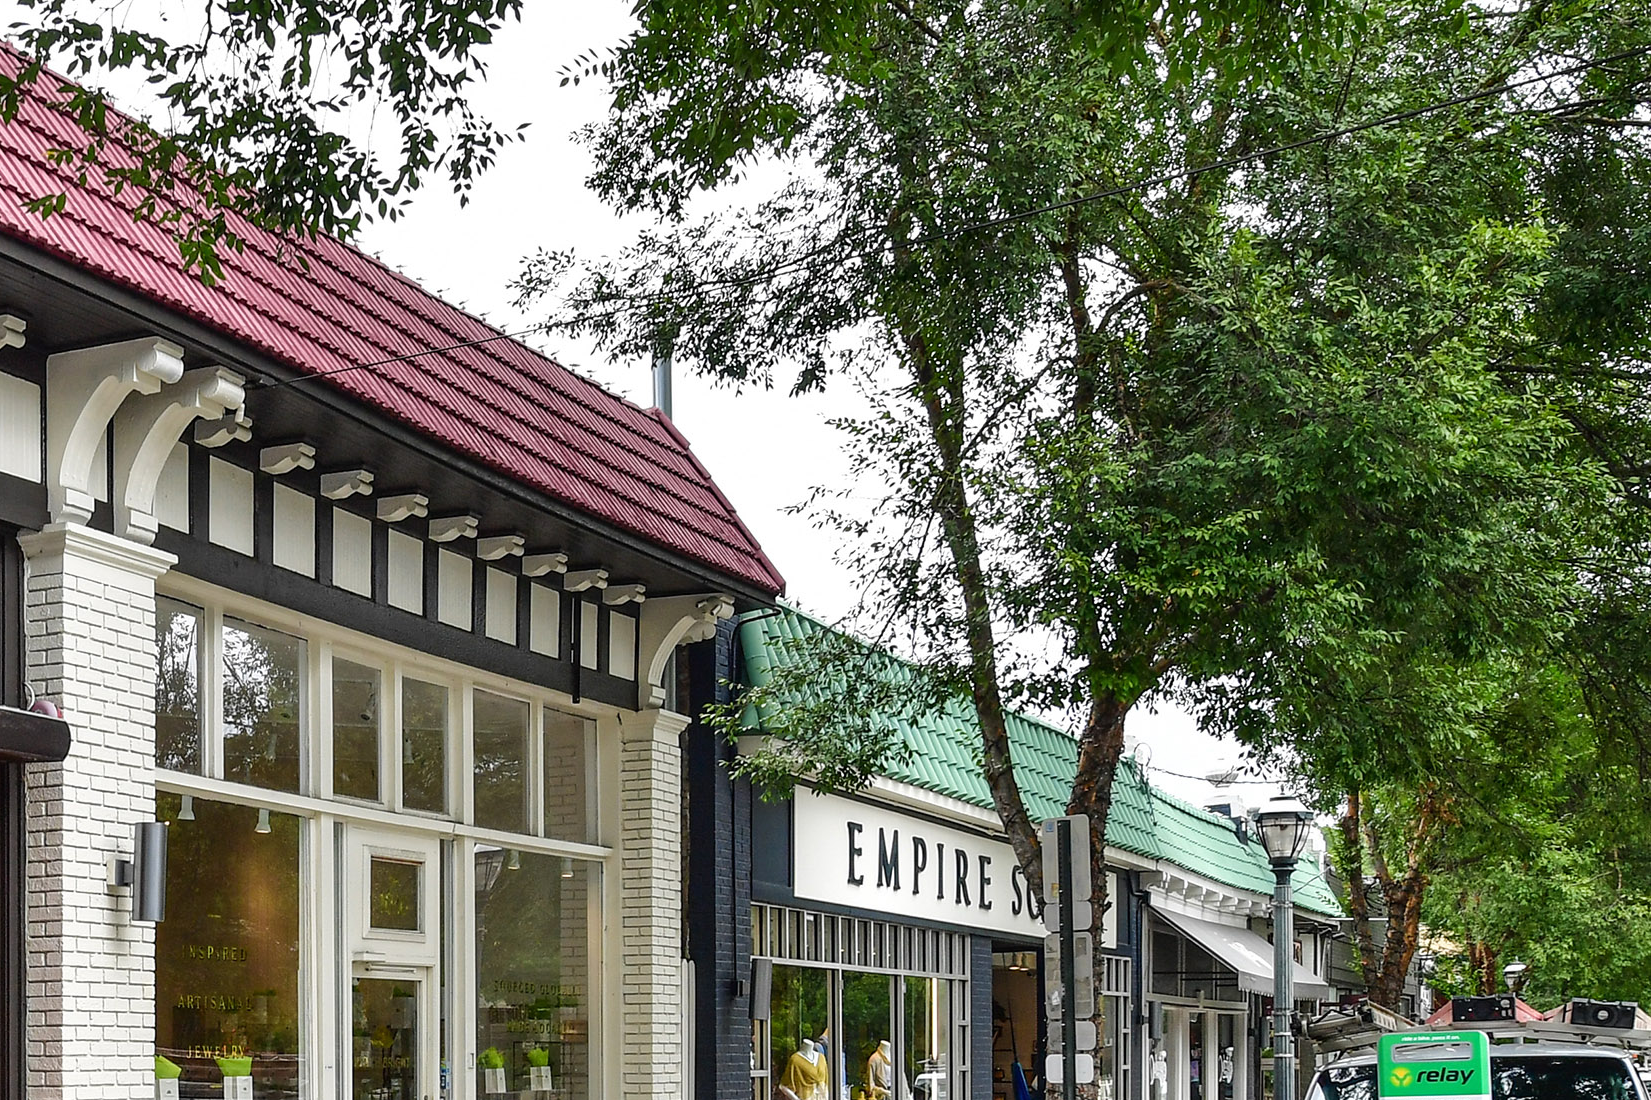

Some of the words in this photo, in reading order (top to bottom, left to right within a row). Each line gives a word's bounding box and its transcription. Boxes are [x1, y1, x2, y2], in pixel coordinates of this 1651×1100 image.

[846, 821, 993, 911] EMPIRE
[182, 944, 248, 962] INSPIRED
[186, 1044, 245, 1059] JEWELRY
[1416, 1067, 1475, 1085] relay
